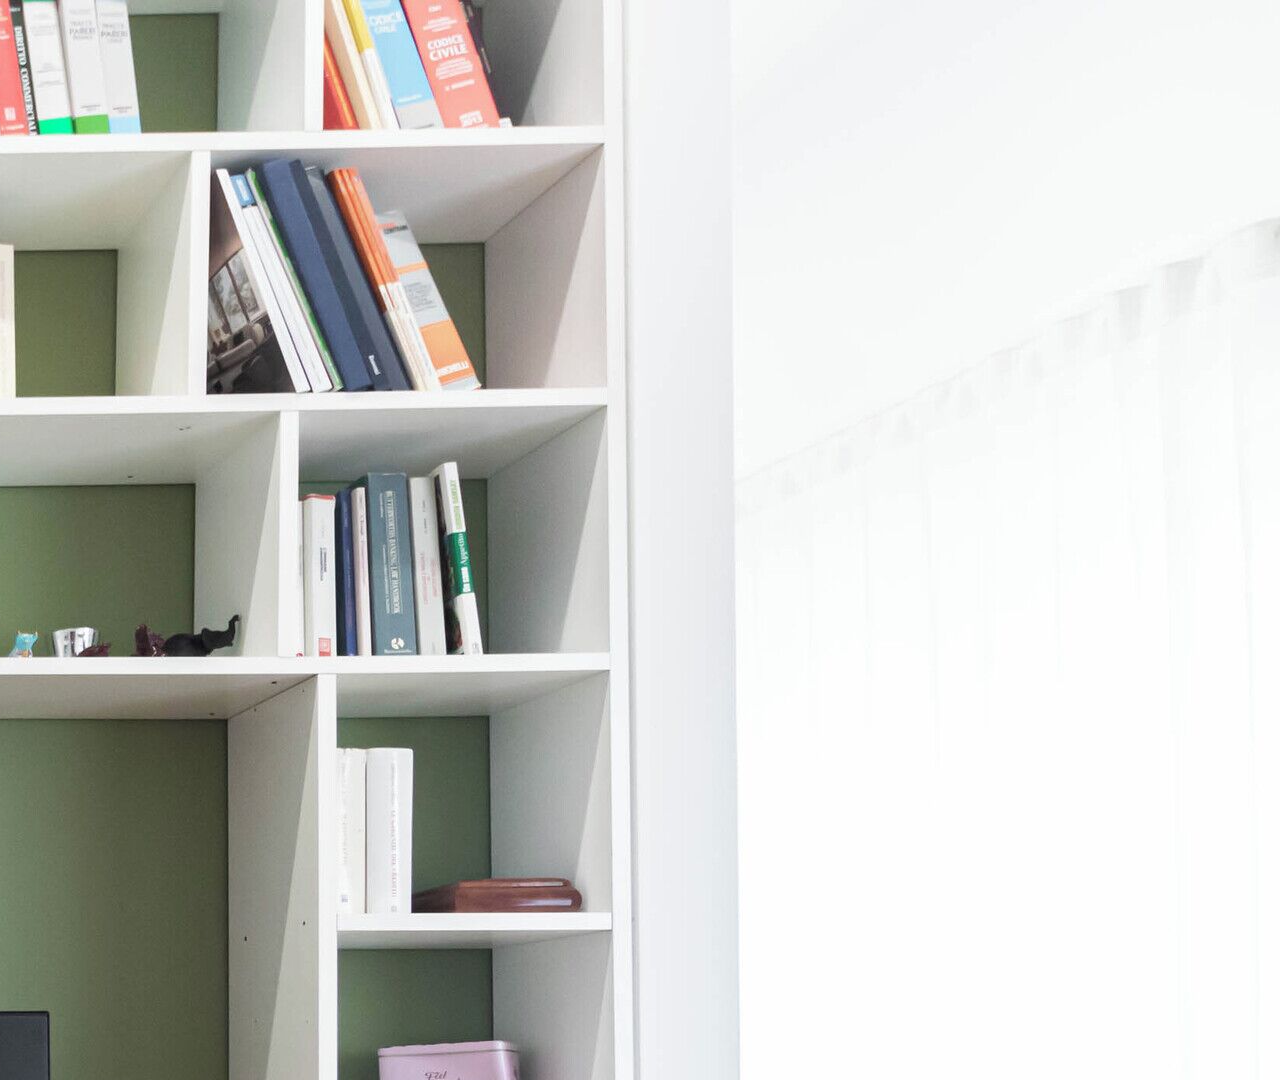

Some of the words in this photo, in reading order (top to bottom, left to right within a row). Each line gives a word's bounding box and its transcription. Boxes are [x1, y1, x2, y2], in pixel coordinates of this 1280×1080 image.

[14, 26, 28, 66] DIRITTO
[427, 34, 464, 50] CODICE
[429, 43, 468, 62] CIVILE
